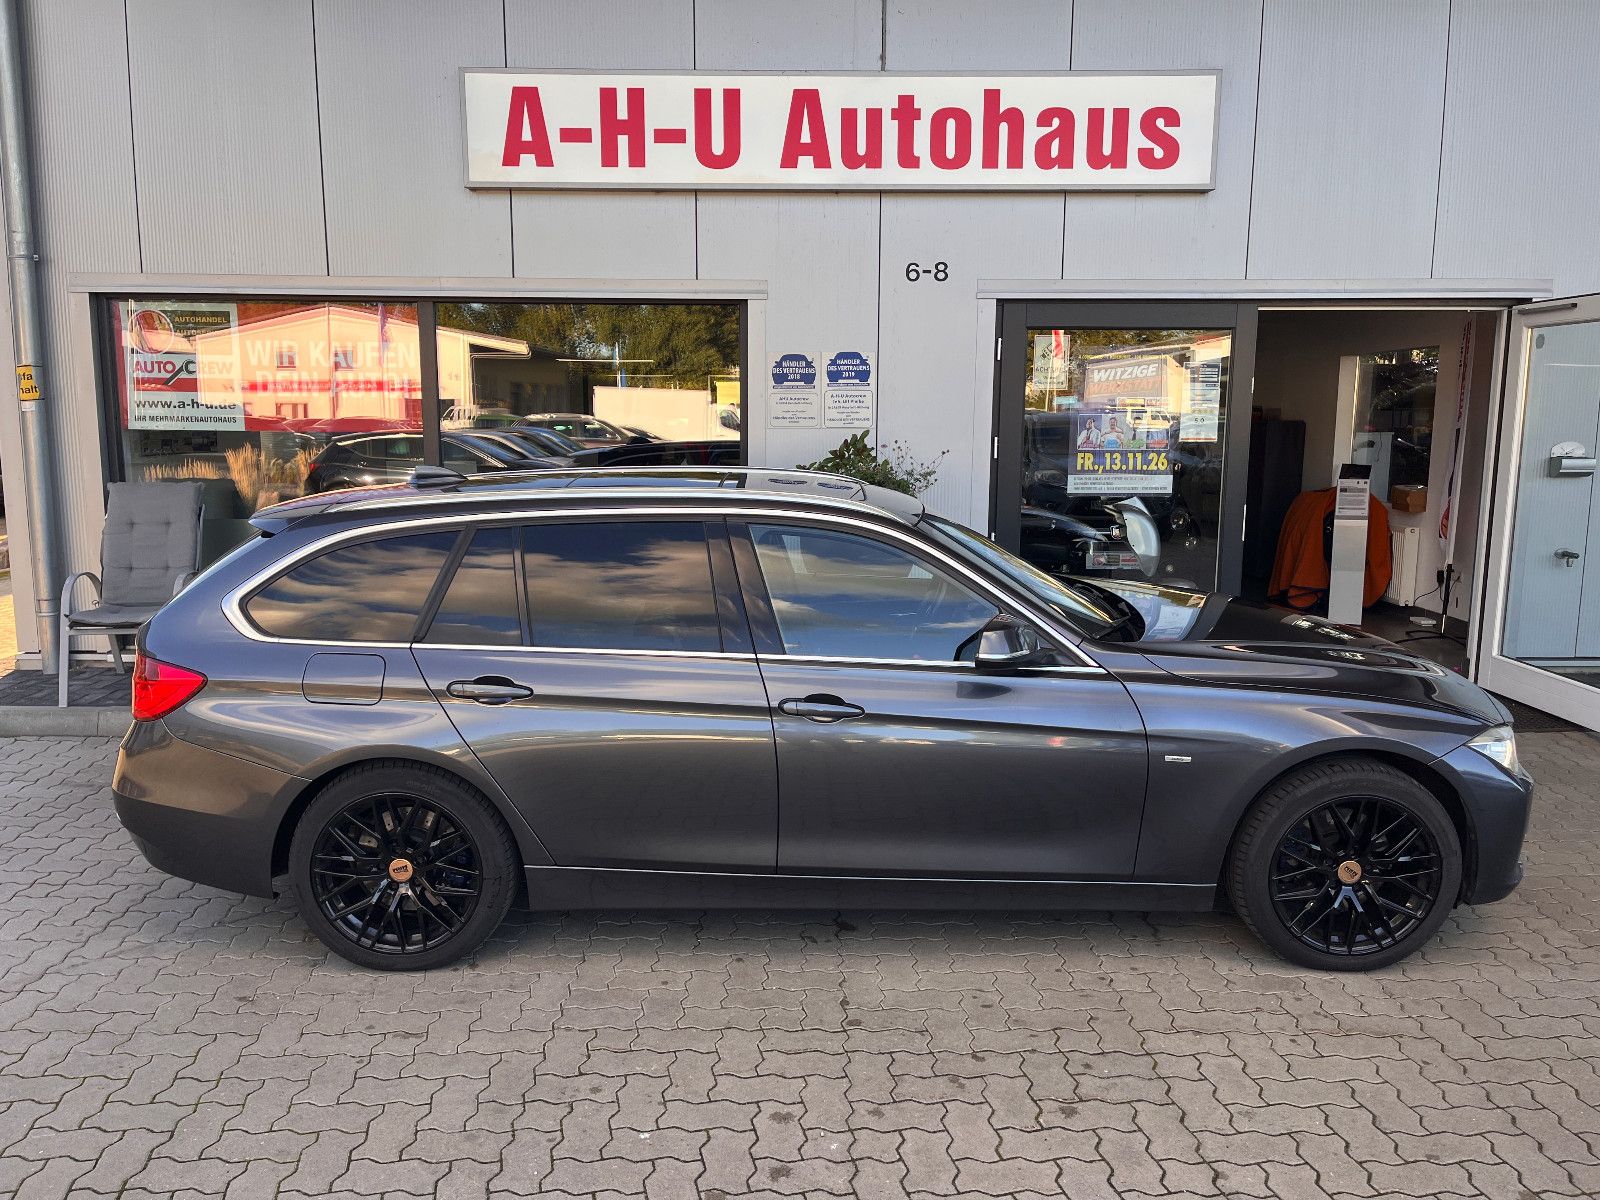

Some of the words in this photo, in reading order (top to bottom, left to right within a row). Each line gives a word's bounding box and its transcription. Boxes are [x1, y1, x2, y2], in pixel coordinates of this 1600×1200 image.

[500, 86, 742, 169] A-H-U
[780, 88, 1181, 170] Autohaus
[905, 261, 949, 283] 6-8
[245, 339, 299, 367] WIR
[309, 340, 417, 369] KAUFEN
[836, 357, 861, 365] HÄNDLER
[135, 360, 177, 374] AUTO
[782, 359, 806, 367] HÄNDLER
[1093, 363, 1159, 382] WITZIGE
[149, 415, 237, 424] MEHRMARKENAUTOHAUS
